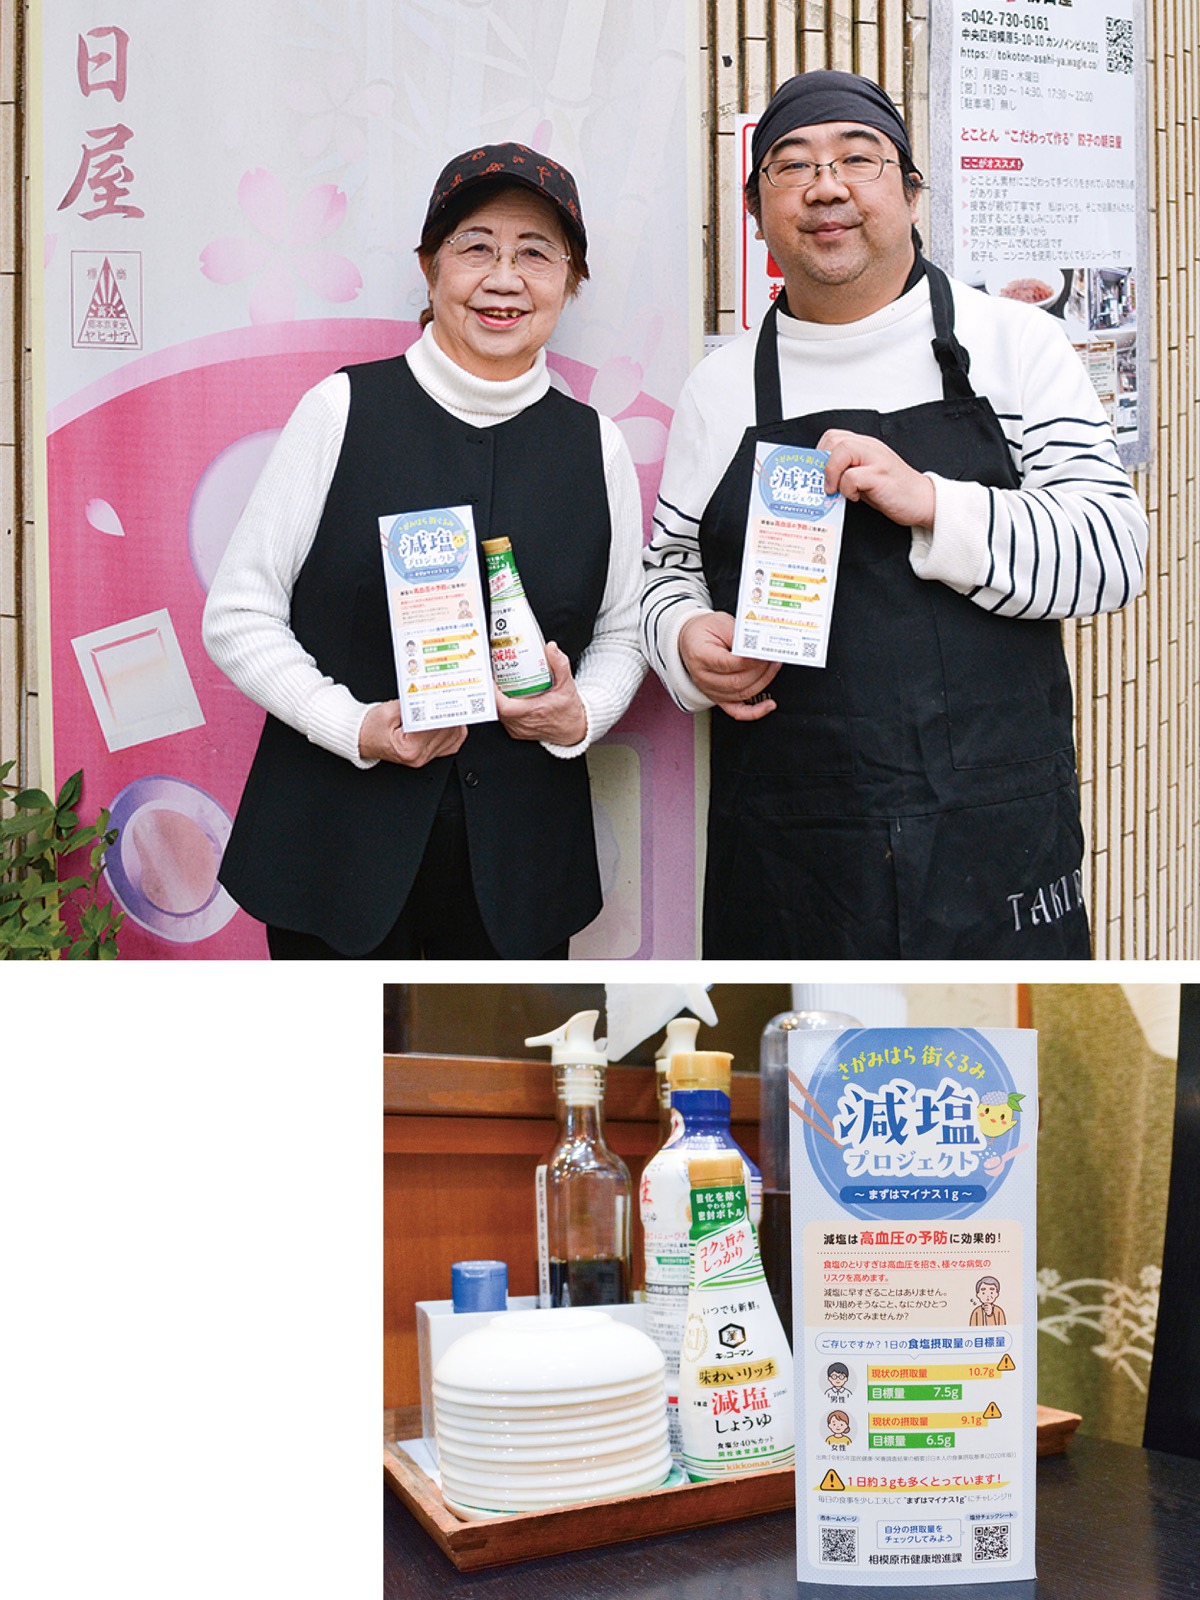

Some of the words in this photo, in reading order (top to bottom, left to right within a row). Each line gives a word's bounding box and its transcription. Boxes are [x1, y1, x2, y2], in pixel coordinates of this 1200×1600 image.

[971, 9, 1050, 31] 042-730-6161
[57, 25, 145, 221] 日屋
[961, 127, 1000, 143] とことん
[401, 530, 455, 555] 減塩
[838, 1046, 916, 1081] さがみはら
[921, 1045, 985, 1080] 街ぐるみ
[839, 1083, 981, 1146] 減塩
[848, 1149, 973, 1172] プロジェクト
[703, 1246, 743, 1273] しっかり
[823, 1259, 991, 1271] 食塩のとりすぎは高血圧を招き、様々な病気の
[823, 1273, 889, 1283] リスクを高めます。
[823, 1288, 948, 1298] 減塩に早すぎることはありません。
[823, 1299, 948, 1310] 取り組めそうなこと、なにかひとつ
[824, 1312, 910, 1322] から始めてみませんか?
[715, 1349, 753, 1360] キッコーマン
[699, 1361, 775, 1386] 味わいリッチ
[871, 1368, 928, 1380] 現状の摂取量
[968, 1367, 995, 1378] 10.7g
[830, 1395, 846, 1404] 男性
[872, 1387, 905, 1399] 目標量
[933, 1386, 959, 1400] 7.5g
[711, 1387, 771, 1415] 減塩
[715, 1414, 772, 1434] しょうゆ
[872, 1416, 929, 1427] 現状の摂取量
[961, 1415, 982, 1427] 9.1g
[831, 1443, 846, 1452] 女性
[873, 1435, 906, 1447] 目標量
[926, 1434, 952, 1448] 6.5g
[726, 1458, 771, 1471] kikkoman
[885, 1524, 943, 1535] 自分の摂取量を
[885, 1534, 953, 1545] チェックしてみよう
[868, 1553, 963, 1566] 相模原市健康増進課
